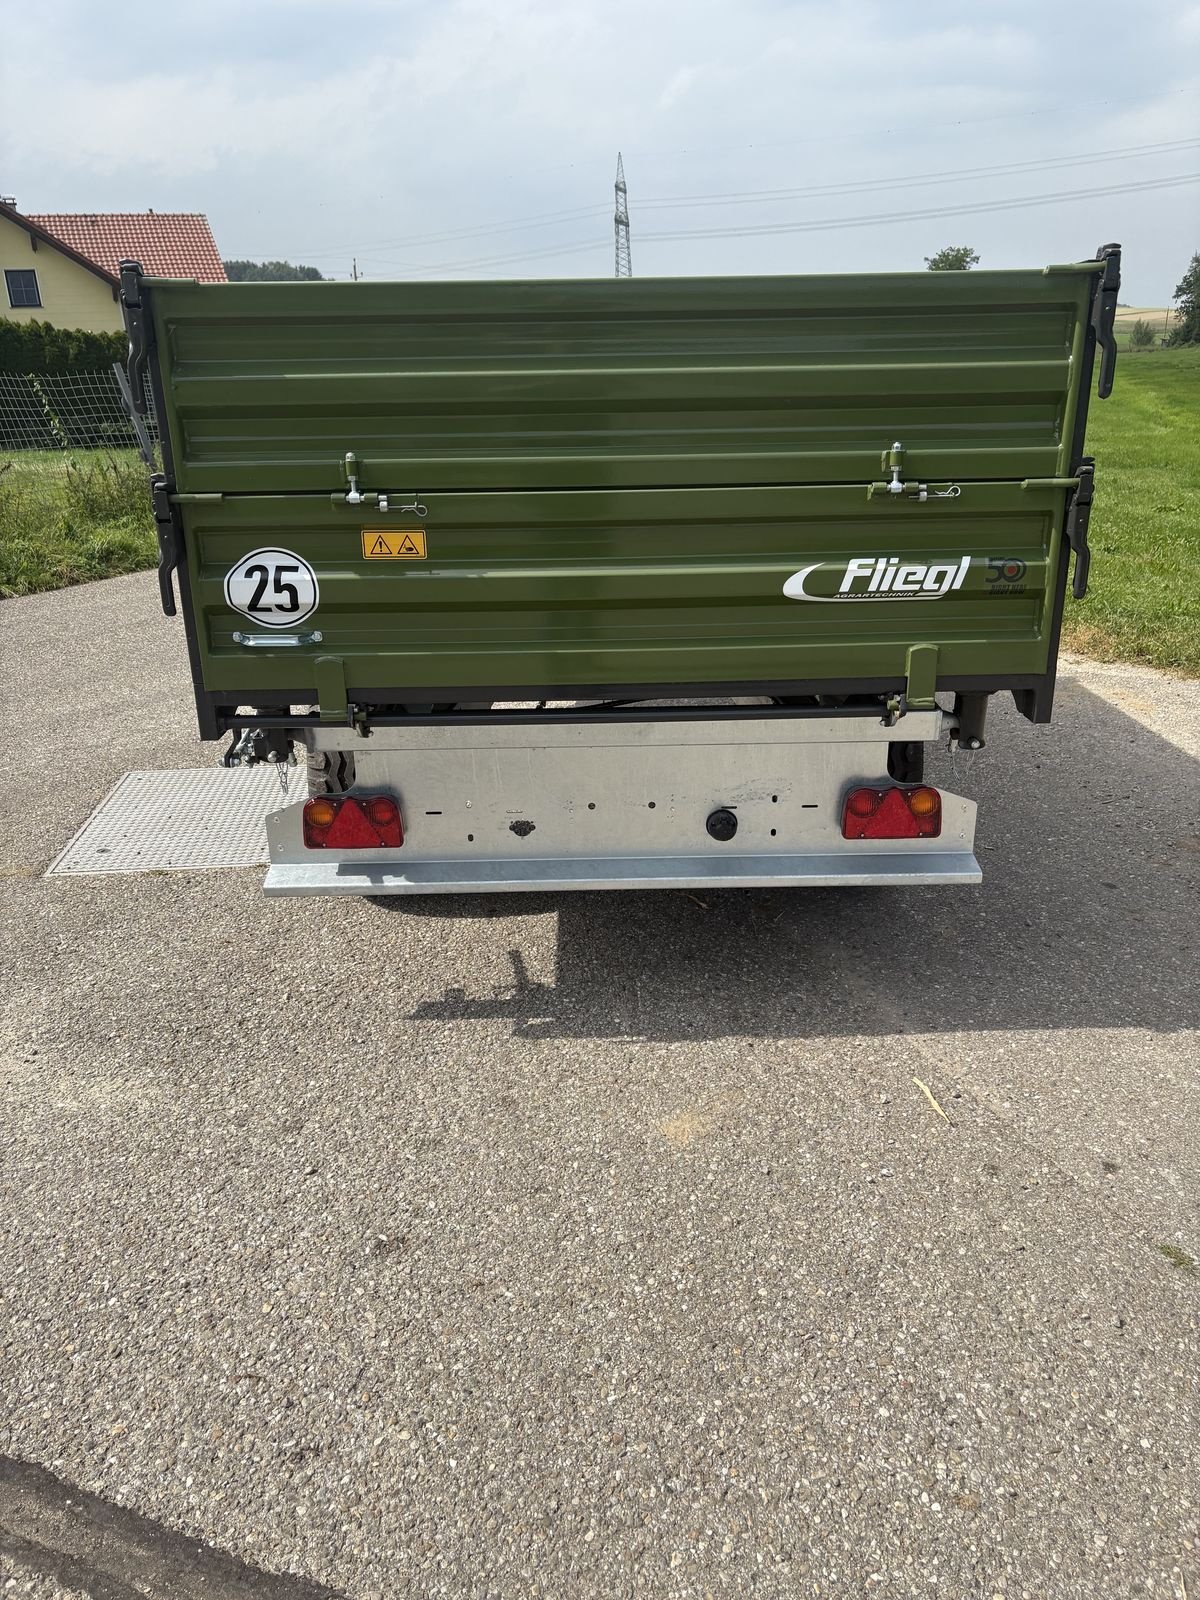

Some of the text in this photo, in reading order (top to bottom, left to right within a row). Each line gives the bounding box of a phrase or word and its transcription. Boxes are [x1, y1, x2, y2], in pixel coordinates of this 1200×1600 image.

[244, 565, 300, 613] 25
[833, 591, 915, 599] AGRARTECHNIK
[838, 556, 972, 596] Fliegl
